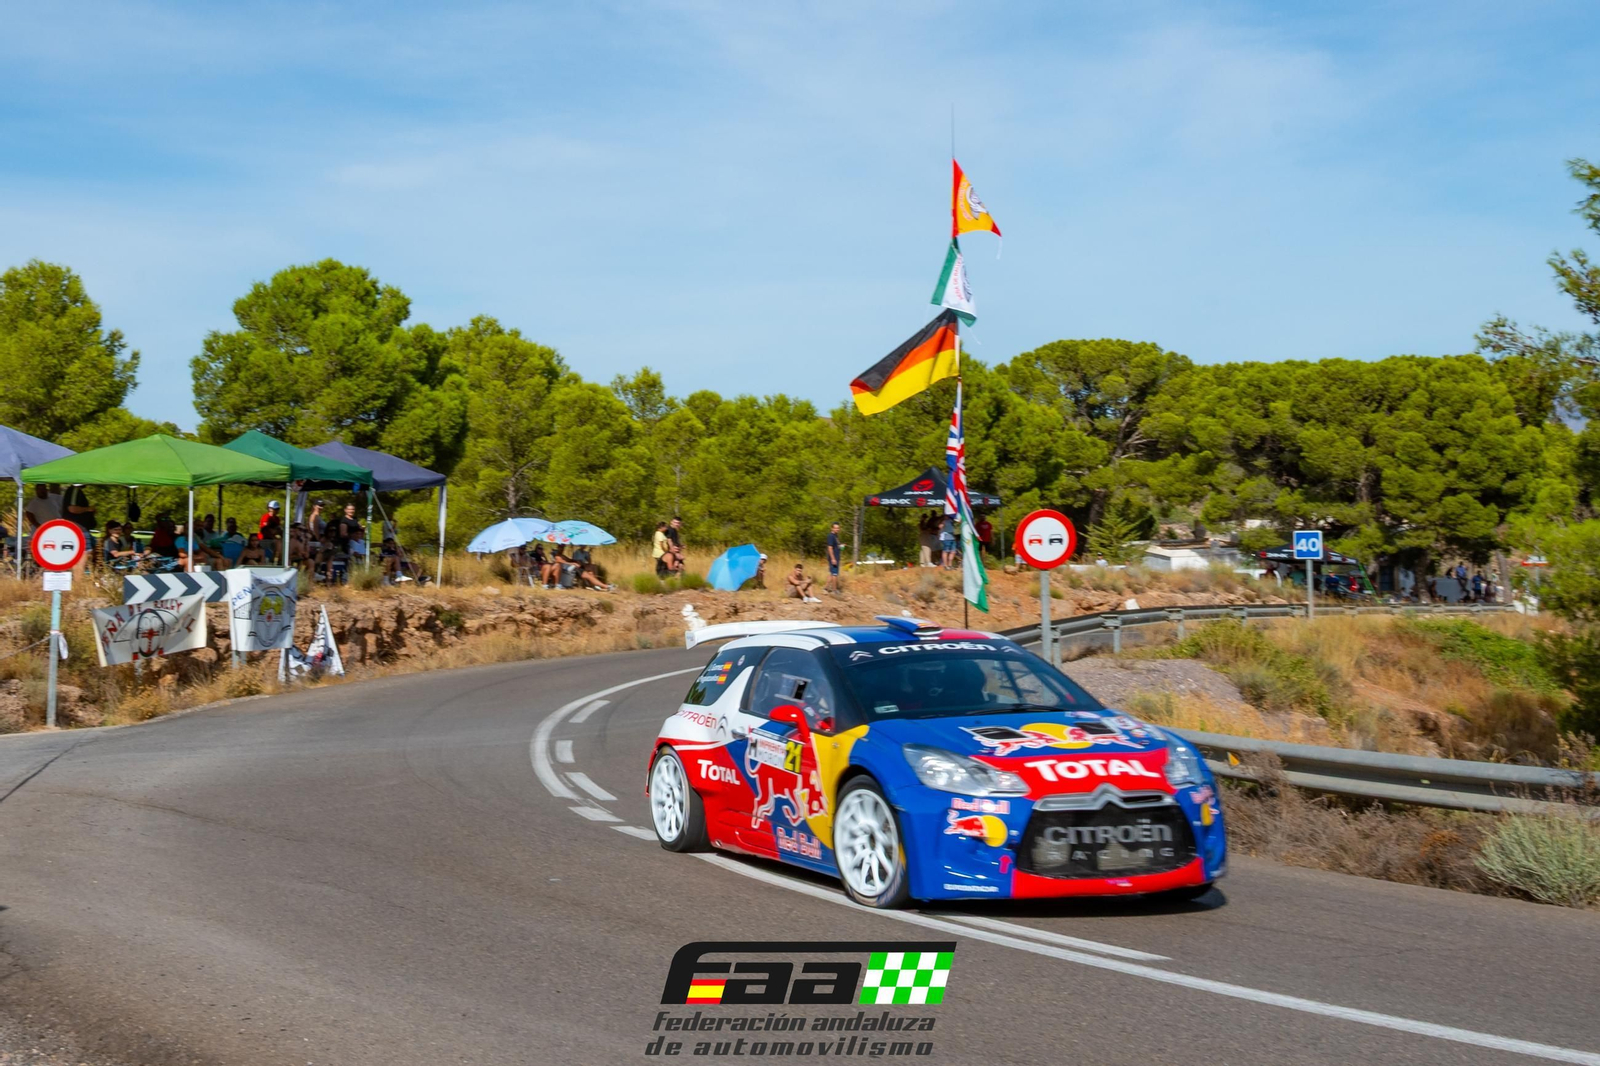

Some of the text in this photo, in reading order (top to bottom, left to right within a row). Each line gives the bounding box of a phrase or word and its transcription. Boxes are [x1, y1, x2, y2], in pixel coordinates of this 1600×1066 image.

[1296, 537, 1320, 553] 40
[878, 641, 998, 655] CITROËN
[784, 741, 804, 773] 21
[697, 758, 741, 786] TOTAL
[1024, 759, 1162, 782] TOTAL
[1043, 818, 1173, 846] CITROËN
